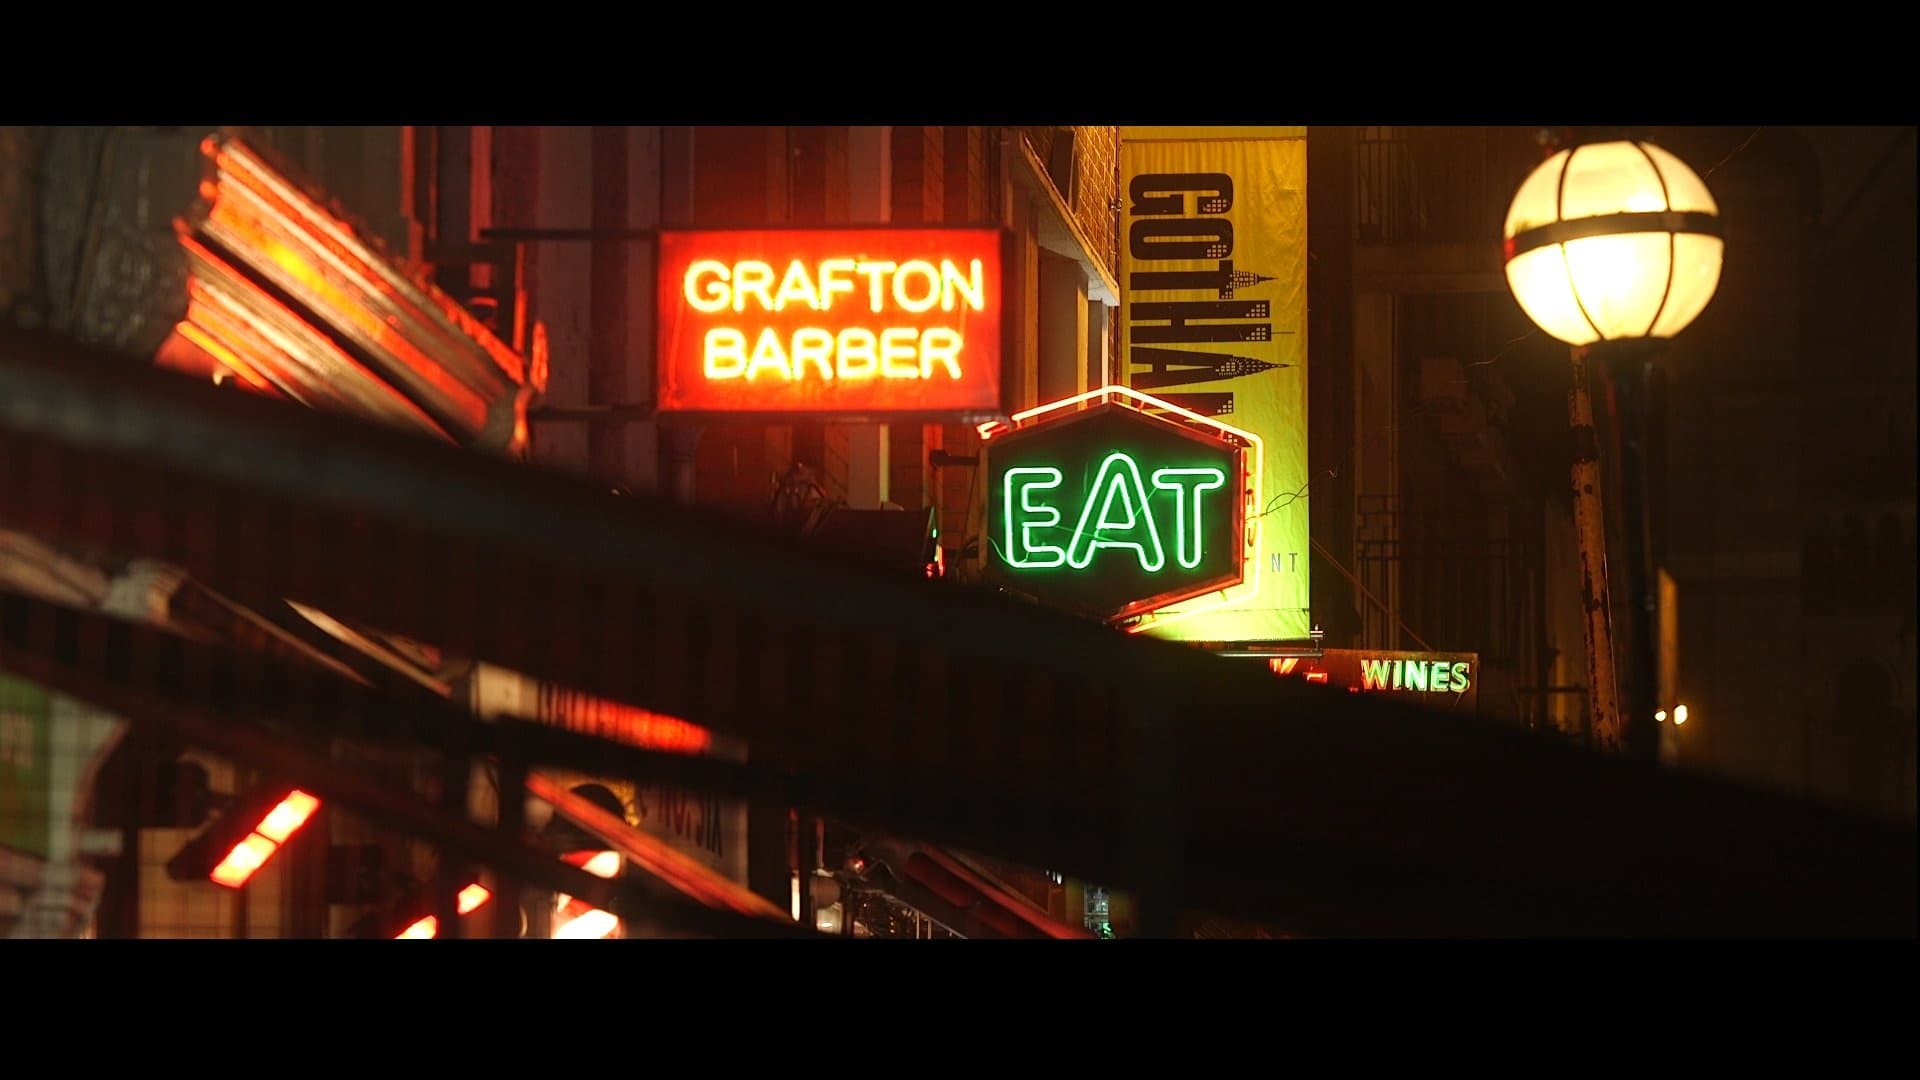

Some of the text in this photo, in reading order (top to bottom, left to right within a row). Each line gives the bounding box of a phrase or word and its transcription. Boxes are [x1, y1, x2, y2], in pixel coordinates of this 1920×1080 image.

[683, 257, 985, 313] GRAFTON
[703, 326, 965, 381] BARBER
[1003, 452, 1226, 573] EAT
[1360, 658, 1471, 693] WINES
